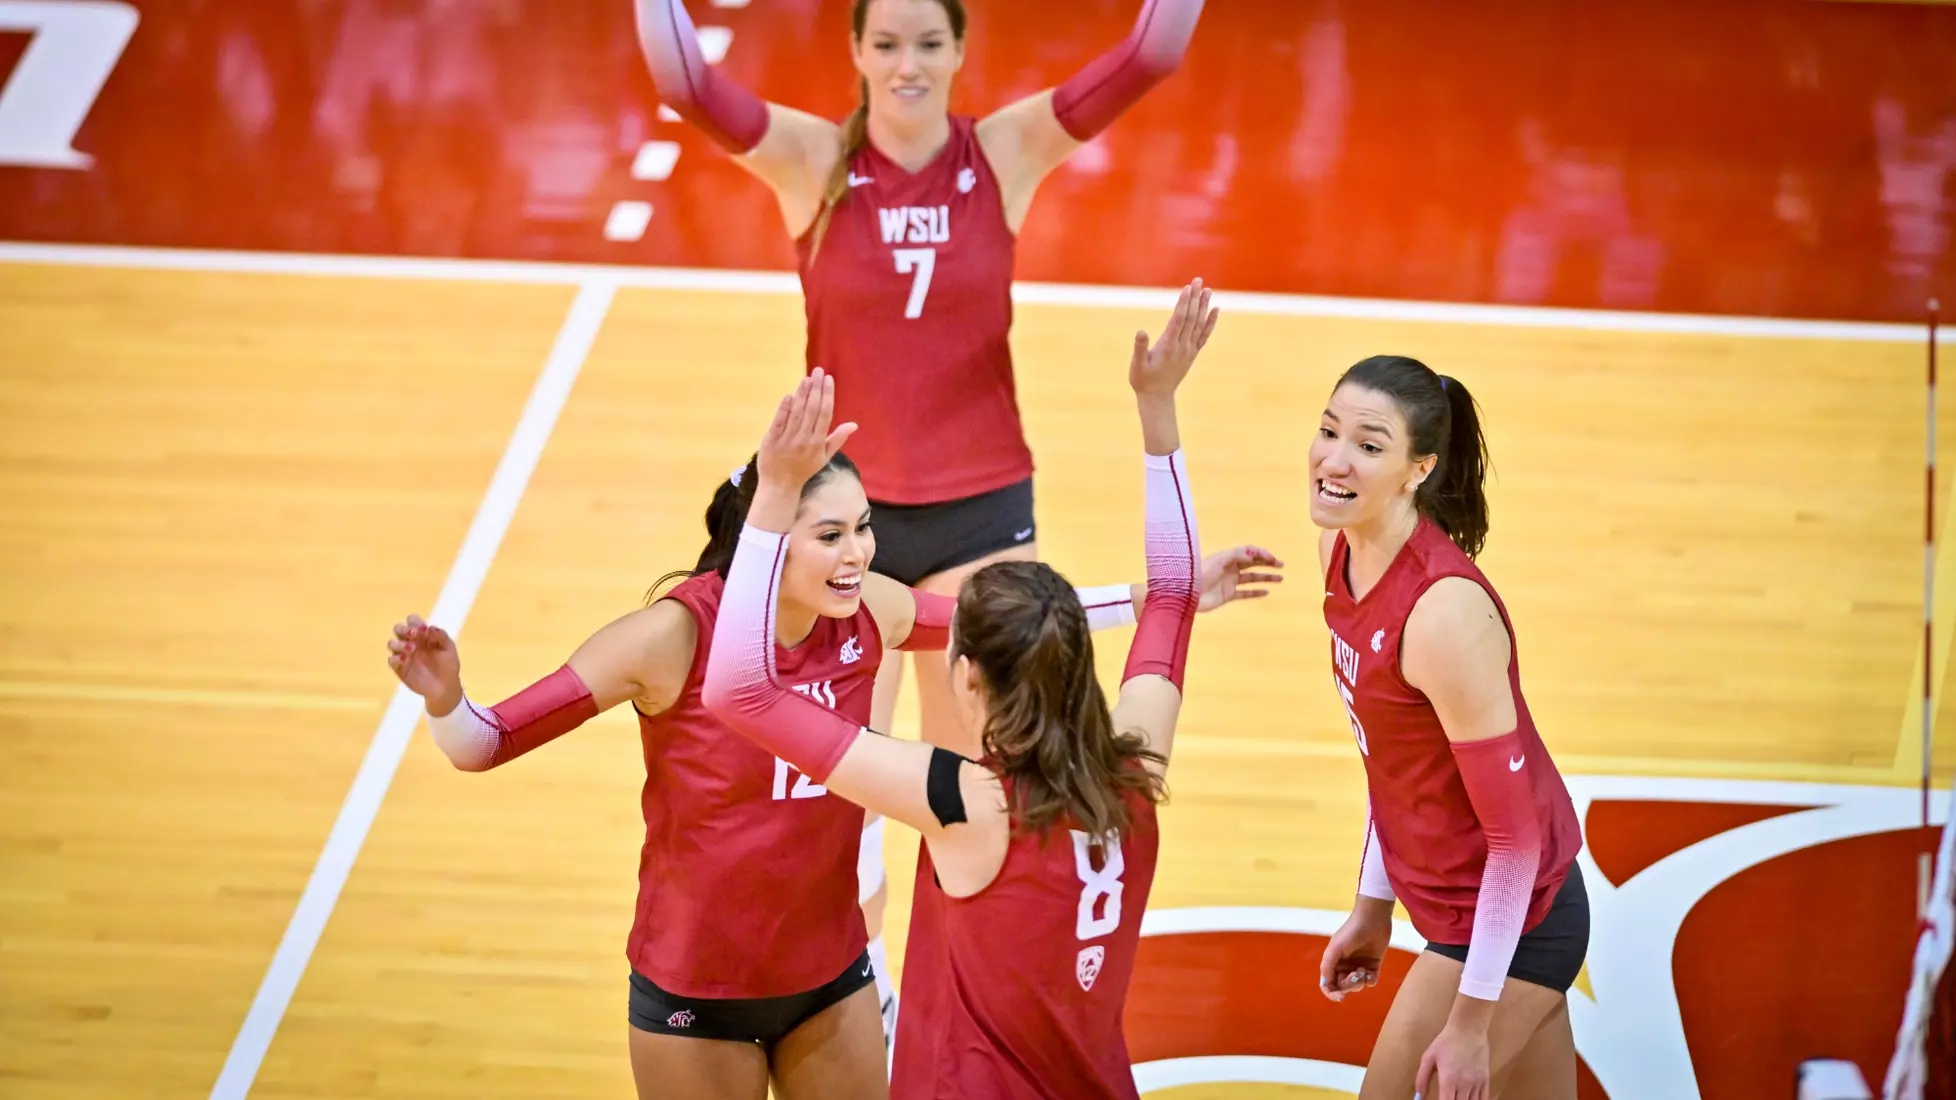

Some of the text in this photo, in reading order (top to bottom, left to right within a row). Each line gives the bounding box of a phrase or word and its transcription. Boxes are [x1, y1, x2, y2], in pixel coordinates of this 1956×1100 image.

[879, 205, 949, 243] WSU
[893, 248, 935, 319] 7
[1069, 828, 1125, 940] 8
